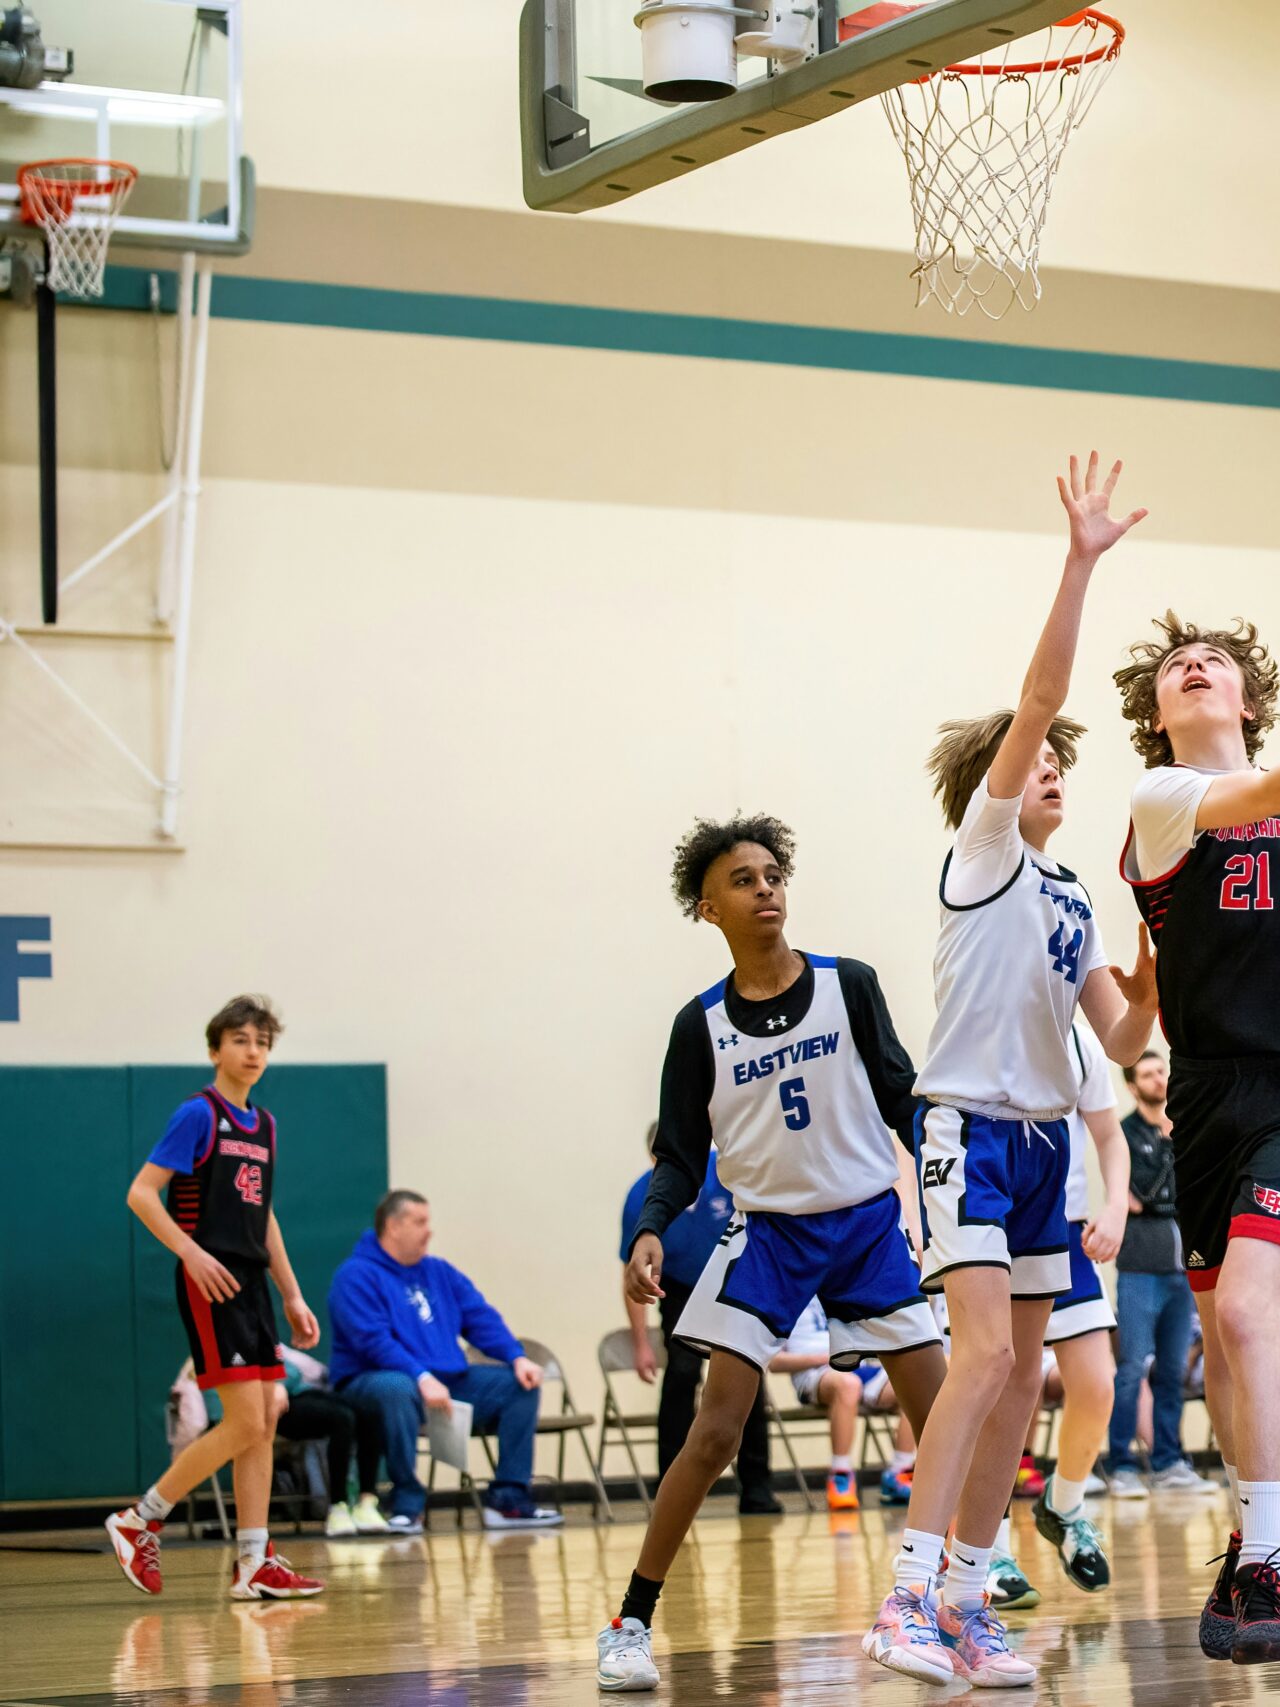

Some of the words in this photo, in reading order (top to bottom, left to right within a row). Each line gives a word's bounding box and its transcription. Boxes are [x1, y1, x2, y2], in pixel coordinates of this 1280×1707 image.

[1219, 851, 1274, 910] 21
[0, 914, 53, 1023] F
[1048, 920, 1083, 984] 44
[733, 1031, 840, 1086] EASTVIEW
[779, 1076, 811, 1131] 5
[233, 1162, 263, 1206] 42
